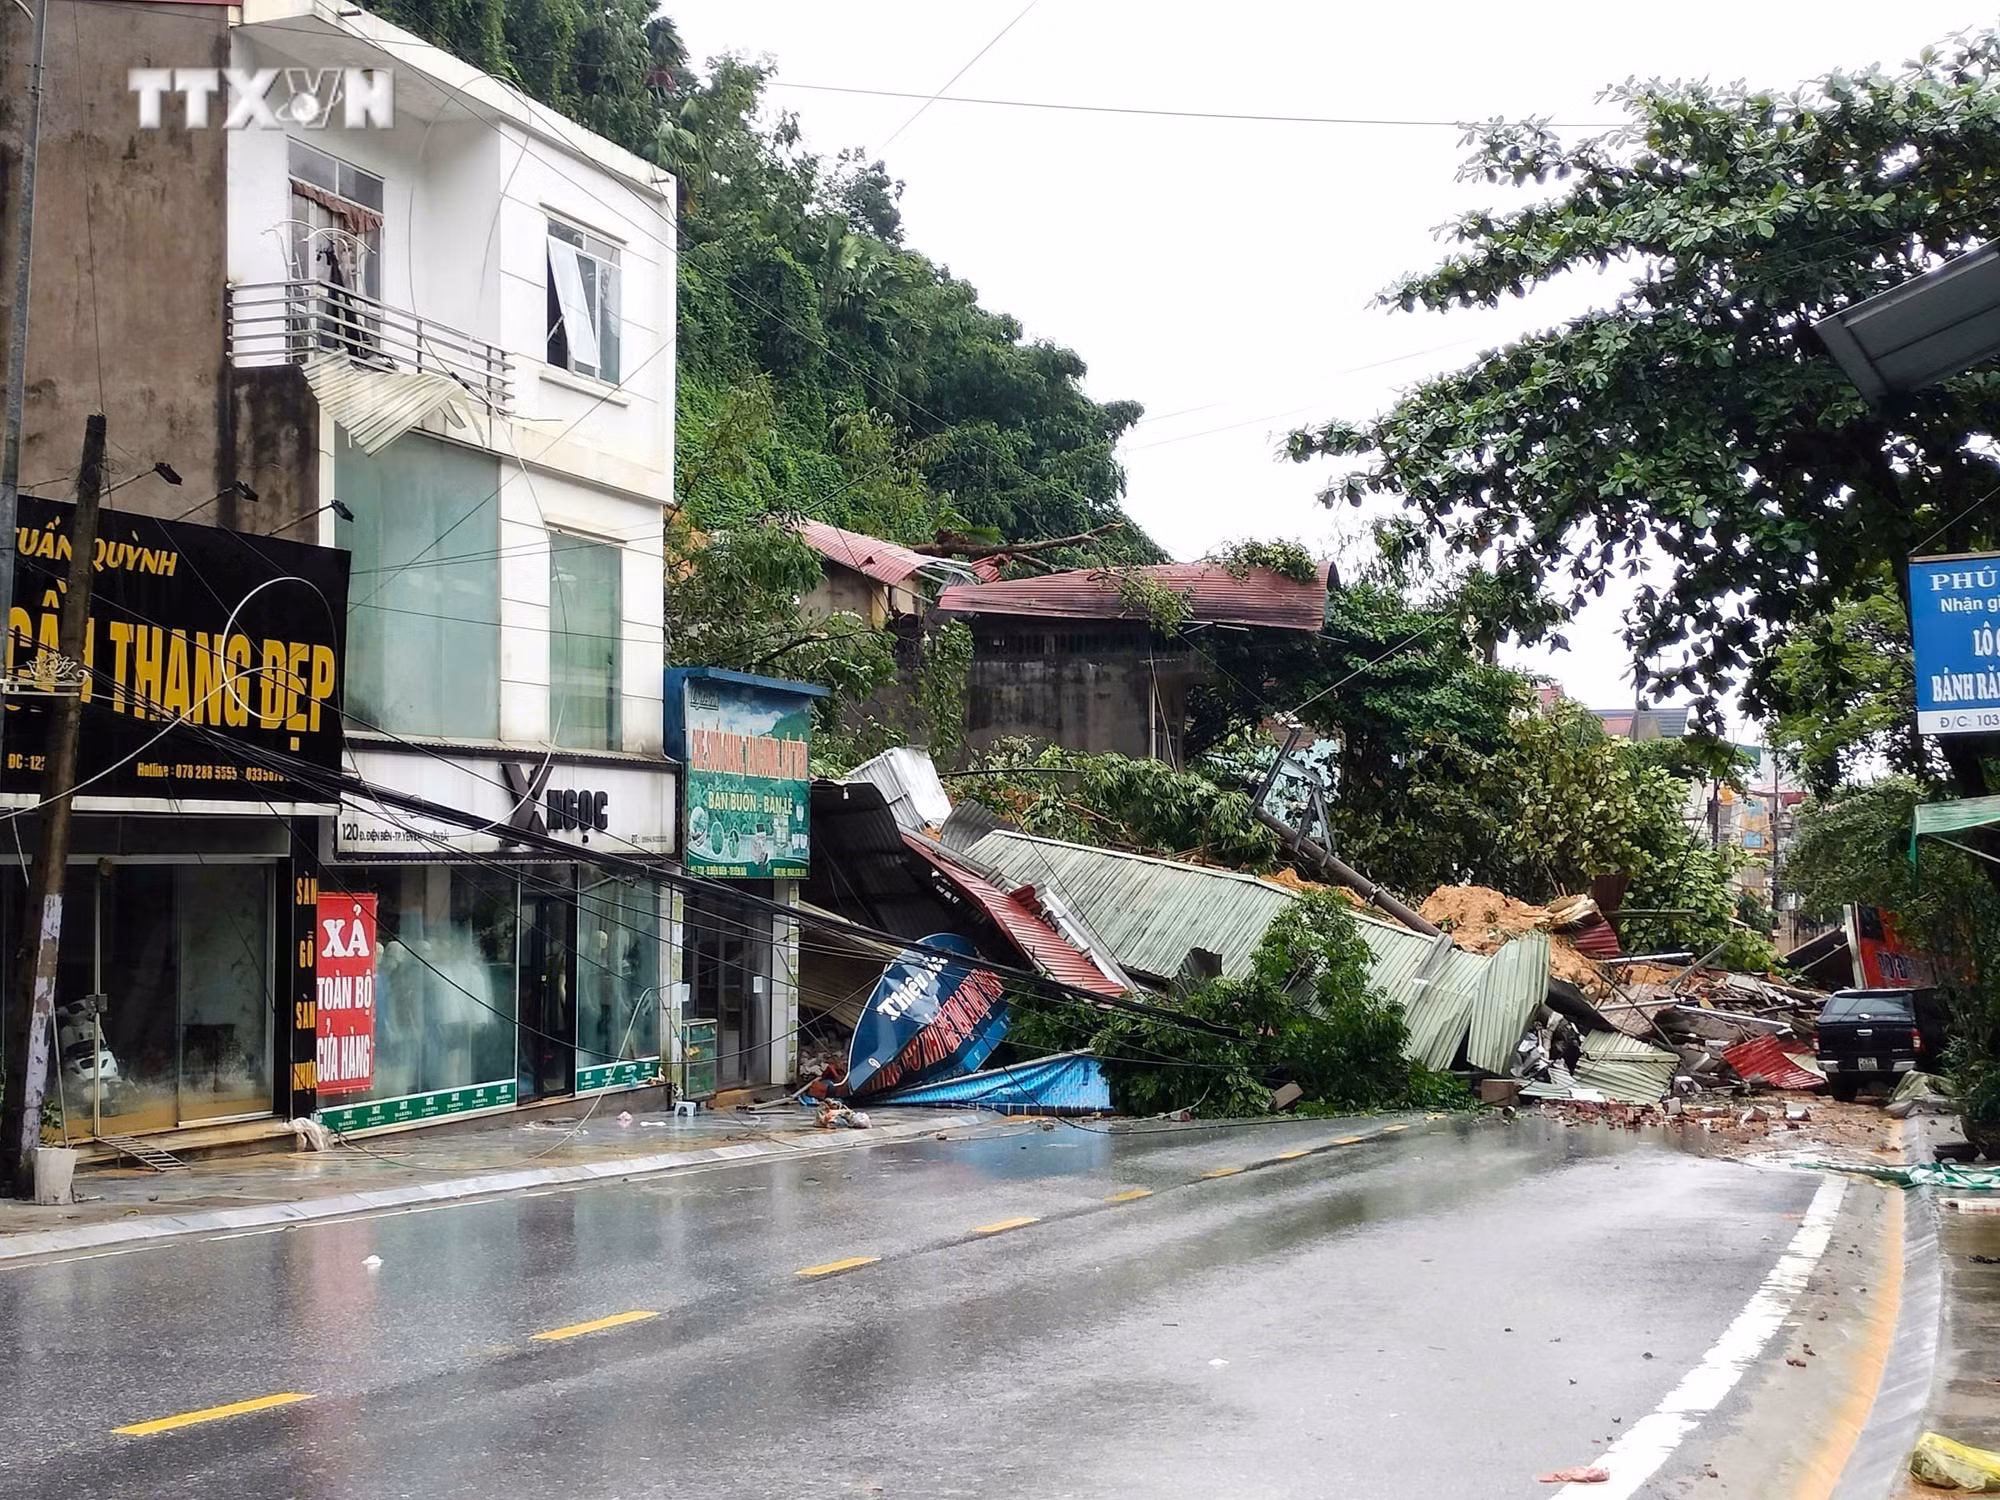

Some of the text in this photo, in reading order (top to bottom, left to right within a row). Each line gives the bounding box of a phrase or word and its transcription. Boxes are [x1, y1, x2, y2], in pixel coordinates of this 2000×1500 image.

[15, 515, 73, 561] UẤN
[1929, 565, 1998, 591] PHÚ
[1941, 598, 1983, 614] Nhận
[1973, 620, 1994, 657] LÔ
[110, 621, 251, 728] THANG
[259, 638, 336, 751] ĐẸP
[1931, 666, 1974, 702] BÁNH
[175, 764, 193, 779] 078
[195, 765, 213, 780] 288
[214, 765, 238, 780] 5555
[546, 789, 609, 844] NGỌC
[763, 790, 782, 814] BÁN
[341, 823, 359, 841] 120
[296, 870, 317, 905] SÀN
[321, 904, 370, 958] XẢ
[317, 968, 373, 1016] TOÀN BỘ
[876, 971, 929, 1021] Thiệu
[295, 993, 316, 1030] SÀN
[316, 1017, 371, 1083] CỬA HÀNG
